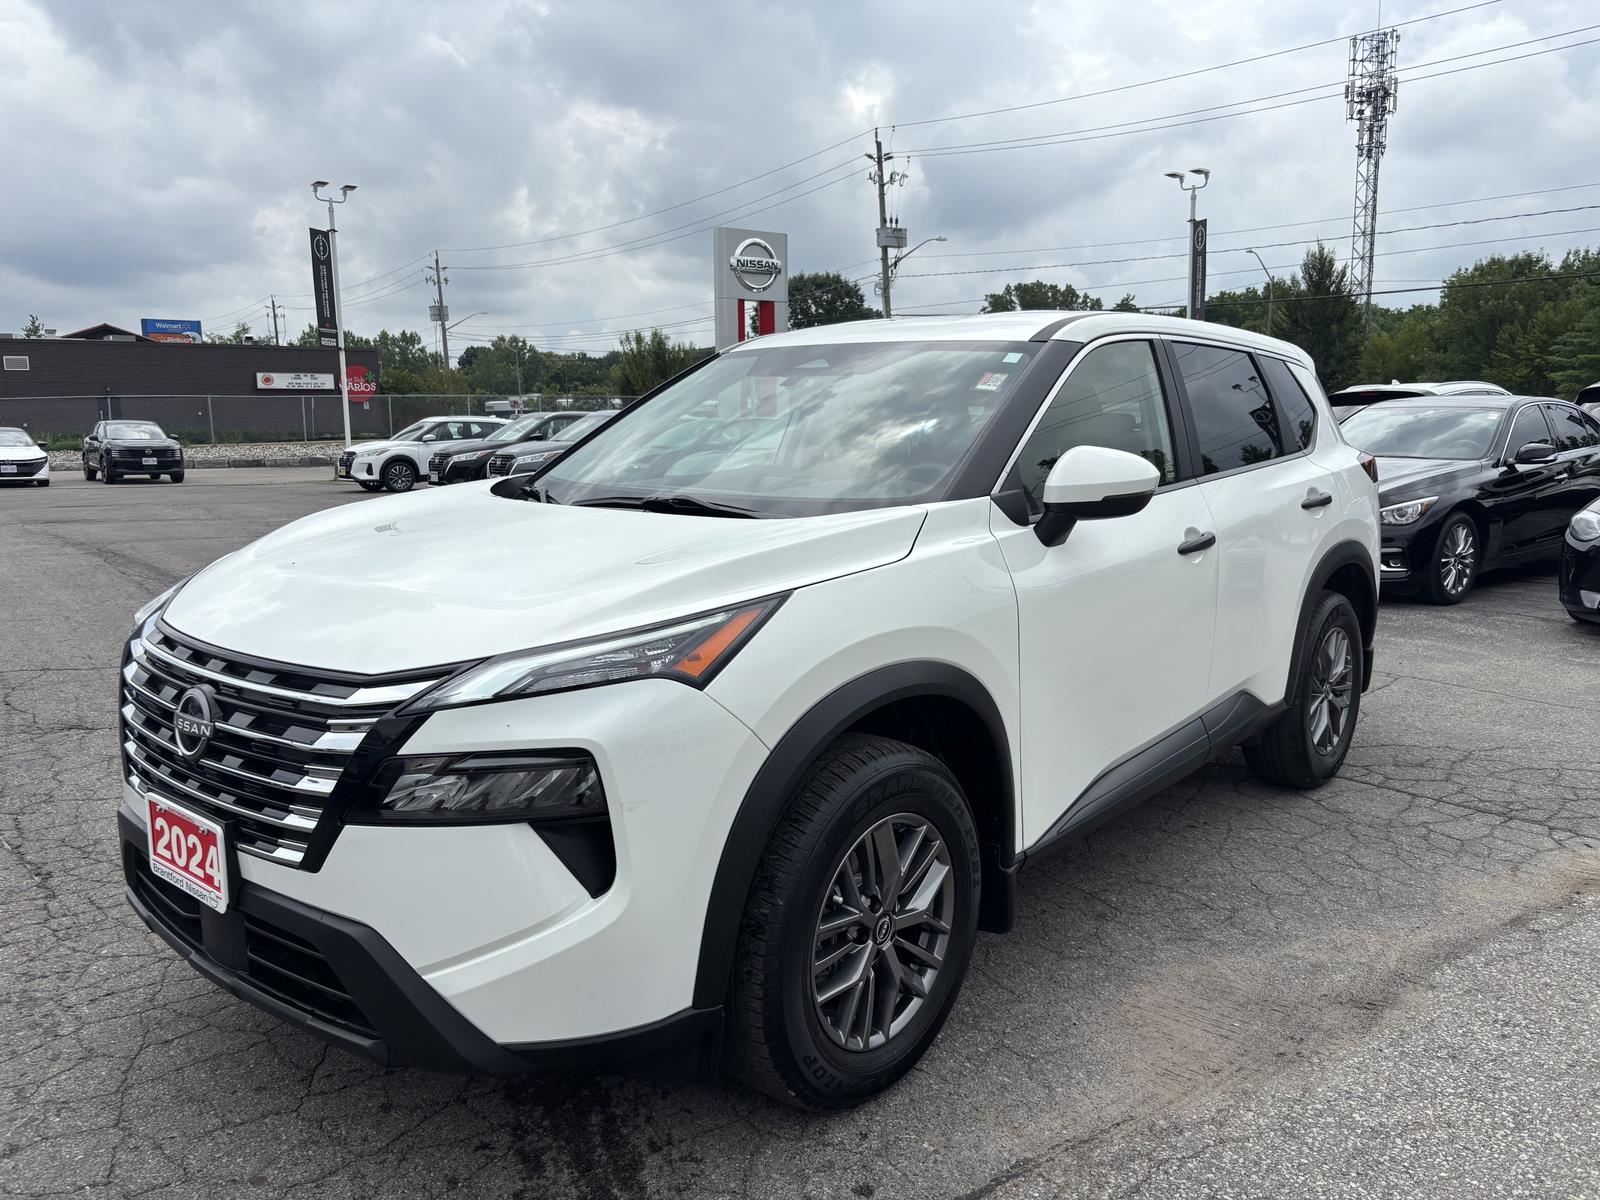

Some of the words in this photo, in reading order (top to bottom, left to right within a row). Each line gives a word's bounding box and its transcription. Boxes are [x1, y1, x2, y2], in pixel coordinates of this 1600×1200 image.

[736, 258, 778, 271] NISSAN
[177, 718, 211, 736] SSAN
[154, 816, 221, 887] 2024
[153, 863, 184, 887] Brantford
[185, 883, 207, 901] Nissan
